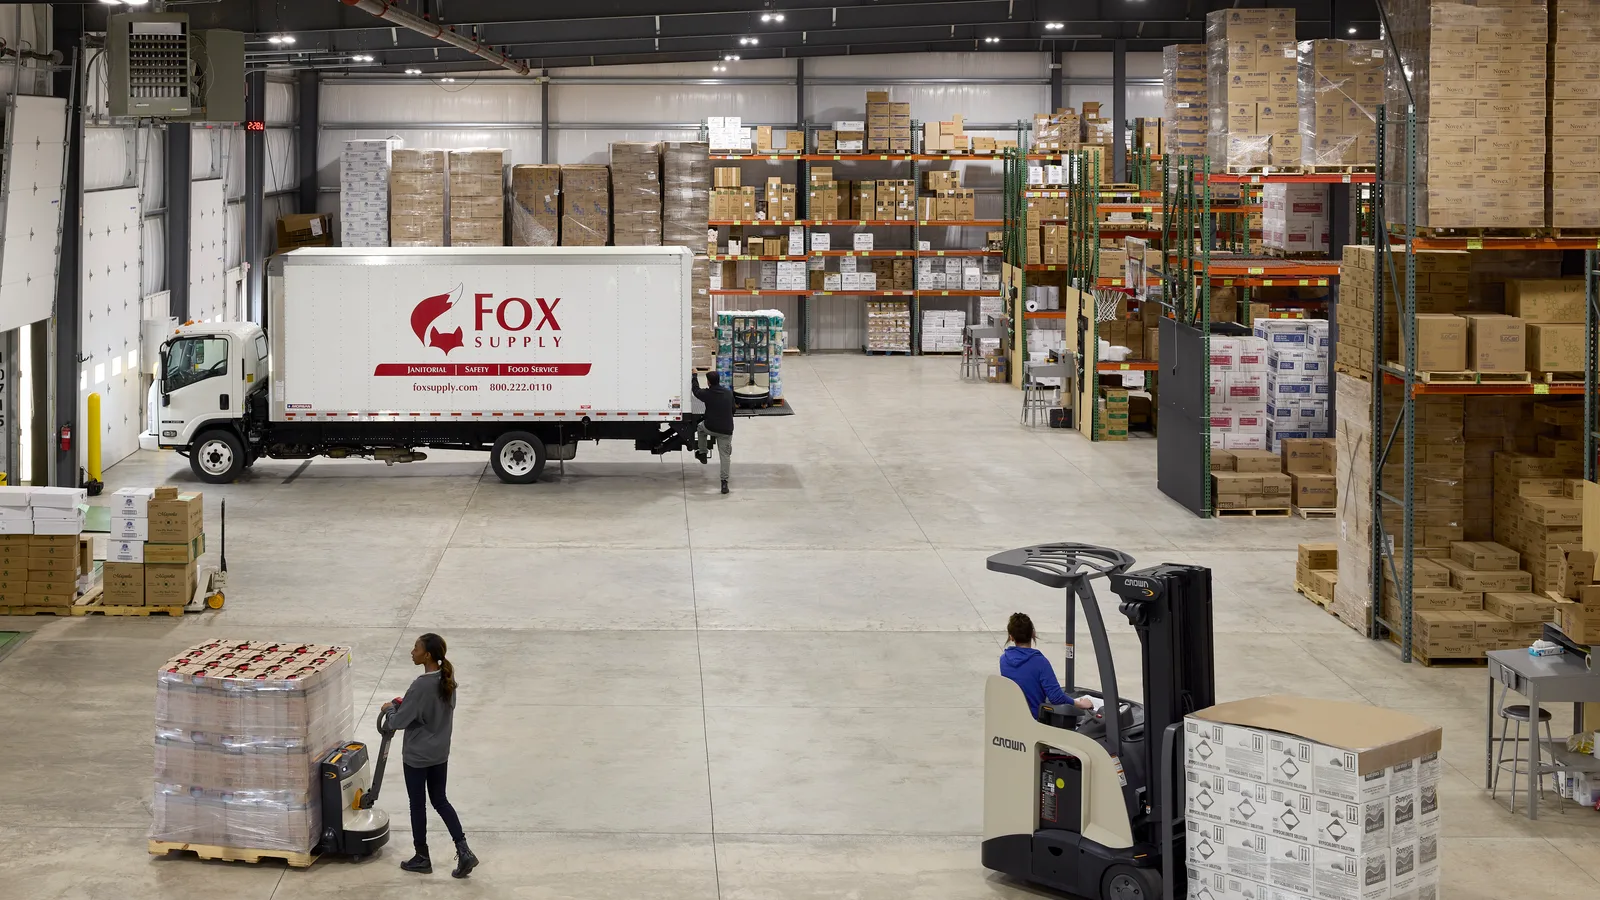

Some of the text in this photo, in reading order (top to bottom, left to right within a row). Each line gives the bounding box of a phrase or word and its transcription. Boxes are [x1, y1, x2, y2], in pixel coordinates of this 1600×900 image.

[474, 293, 562, 331] FOX
[474, 336, 562, 348] SUPPLY
[413, 383, 552, 393] foxsupply.com 800.222.0110
[1124, 579, 1148, 588] CROWN
[992, 736, 1026, 752] CROWN
